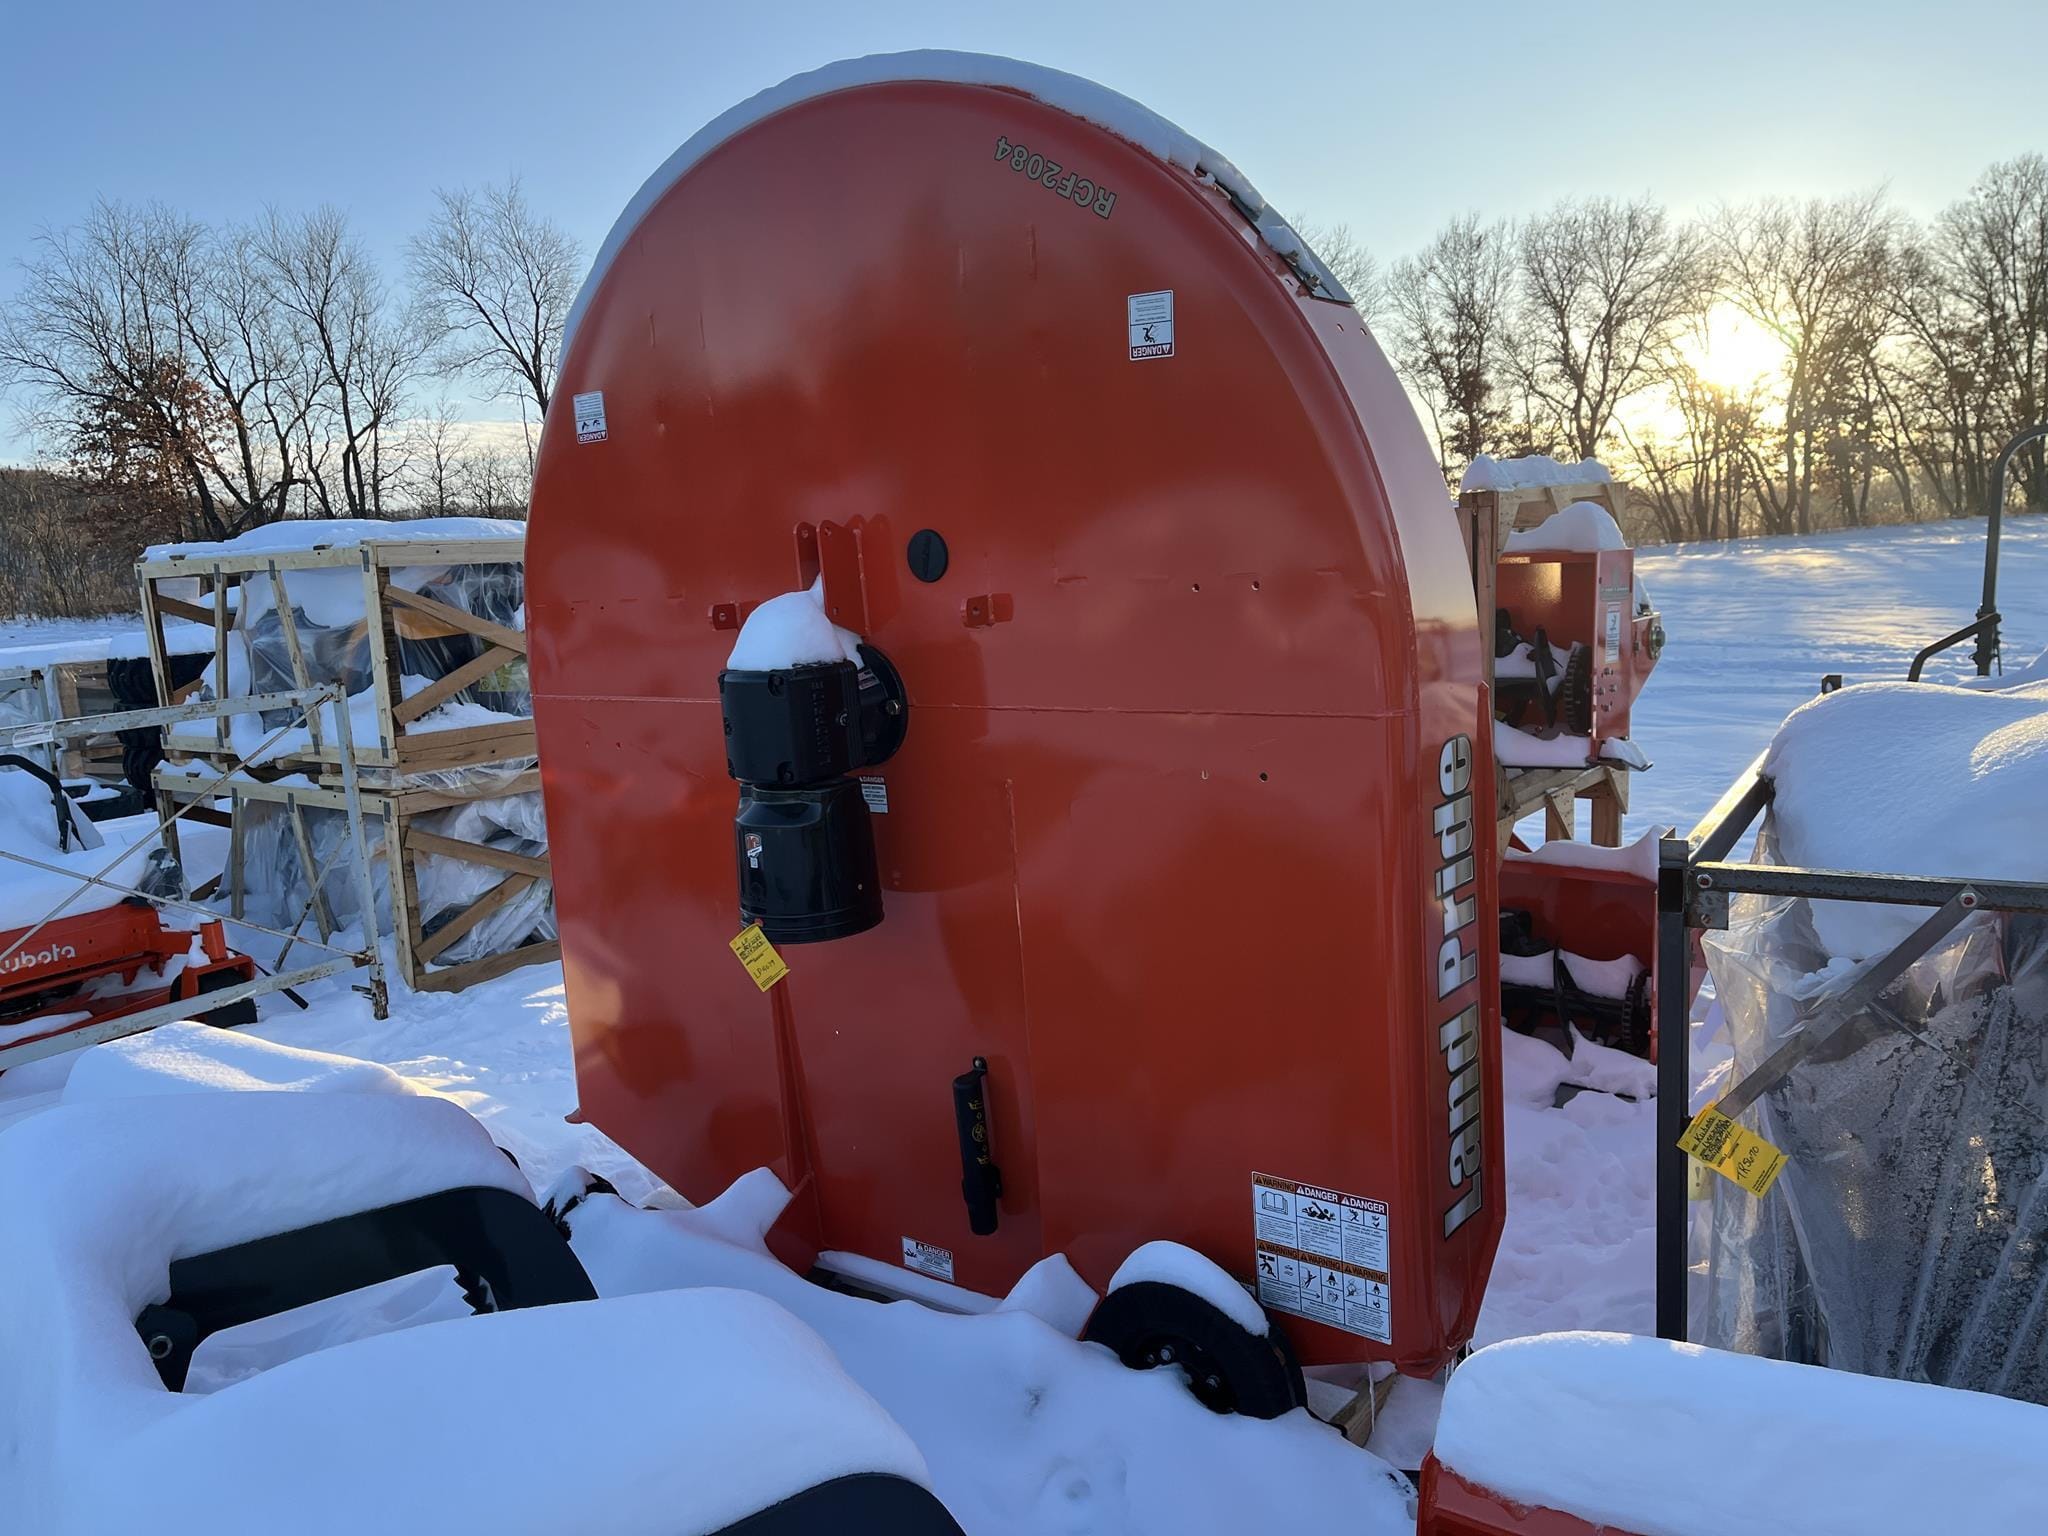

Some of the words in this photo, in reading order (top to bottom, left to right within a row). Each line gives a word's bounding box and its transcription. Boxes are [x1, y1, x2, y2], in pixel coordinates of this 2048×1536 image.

[994, 136, 1117, 219] RCF2084
[1133, 345, 1162, 357] DANGER
[579, 432, 601, 442] DANGER
[1434, 733, 1477, 1001] Pride
[1440, 1002, 1482, 1239] Land
[1263, 1177, 1295, 1192] WARNING
[1305, 1187, 1338, 1202] DANGER
[1351, 1198, 1385, 1213] DANGER
[924, 1245, 949, 1258] DANGER
[1267, 1244, 1298, 1259] WARNING
[1308, 1255, 1342, 1270] WARNING
[1353, 1267, 1386, 1282] WARNING
